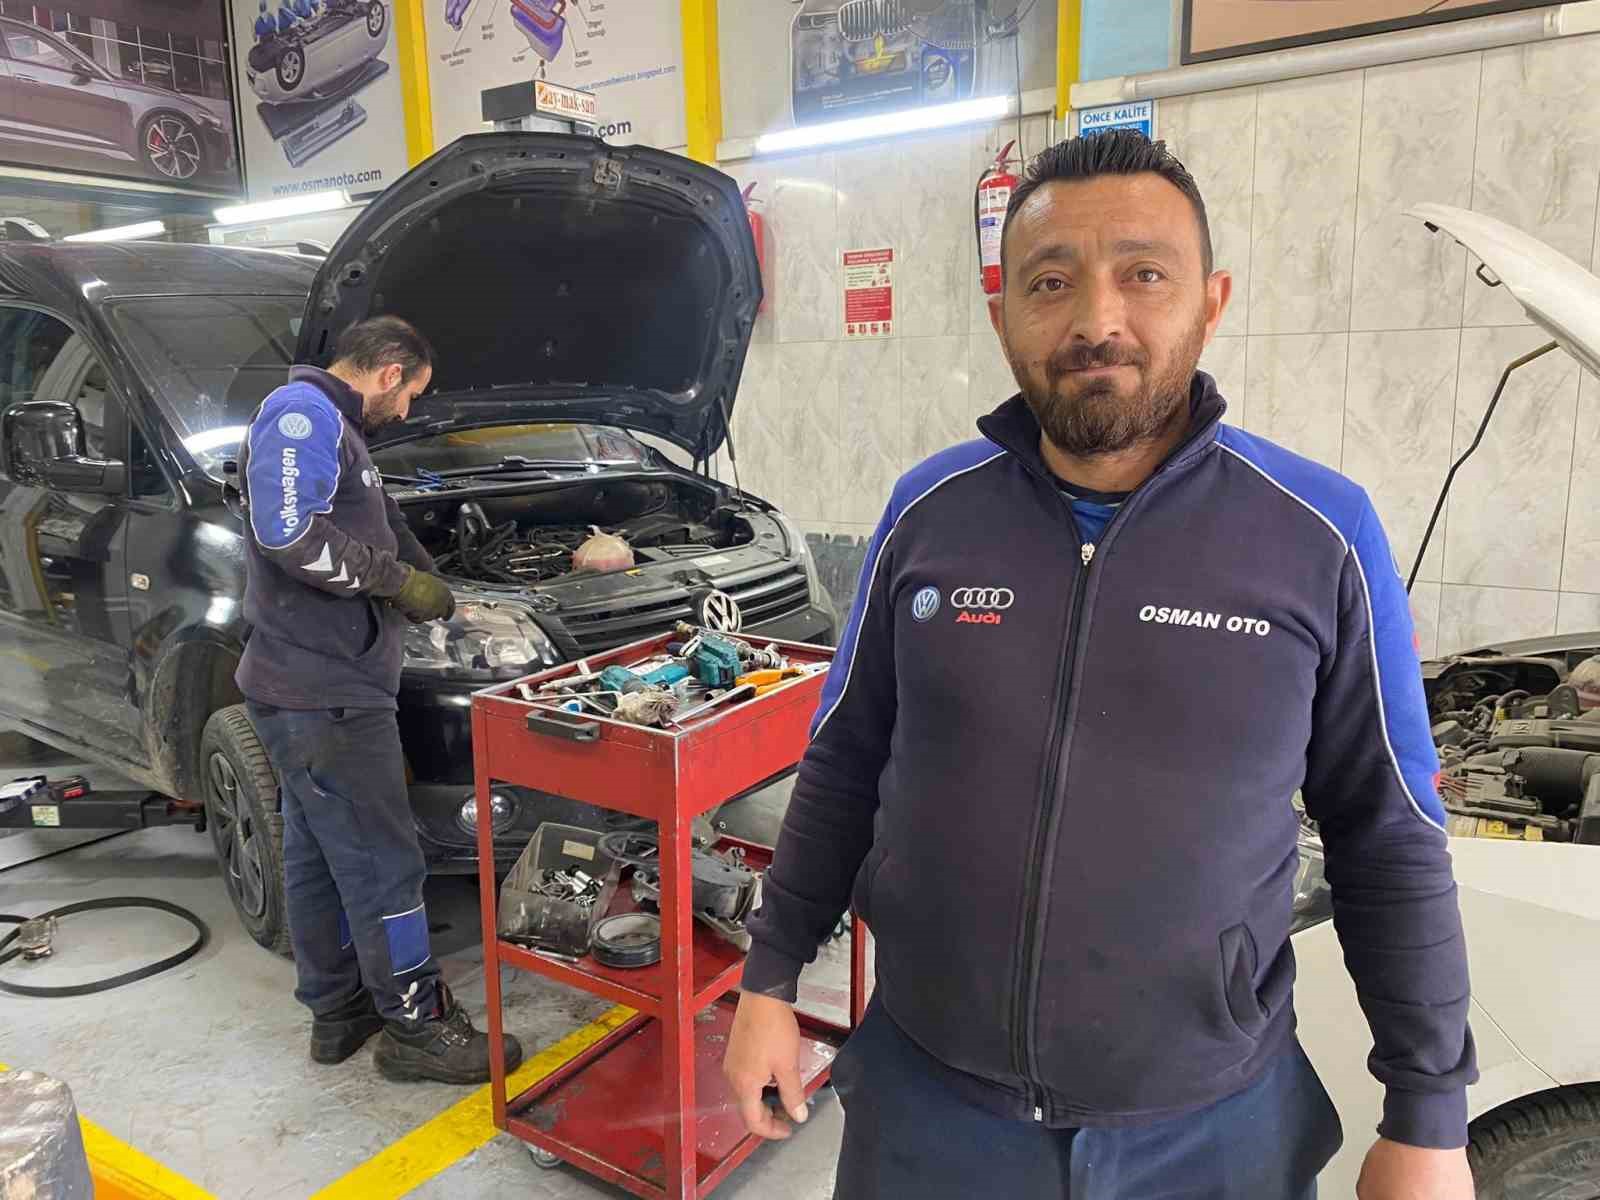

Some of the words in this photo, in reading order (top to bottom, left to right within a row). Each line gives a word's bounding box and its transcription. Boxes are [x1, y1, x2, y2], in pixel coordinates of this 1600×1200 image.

[956, 610, 1002, 625] Audi
[1139, 604, 1222, 629] OSMAN
[1226, 616, 1271, 636] OTO
